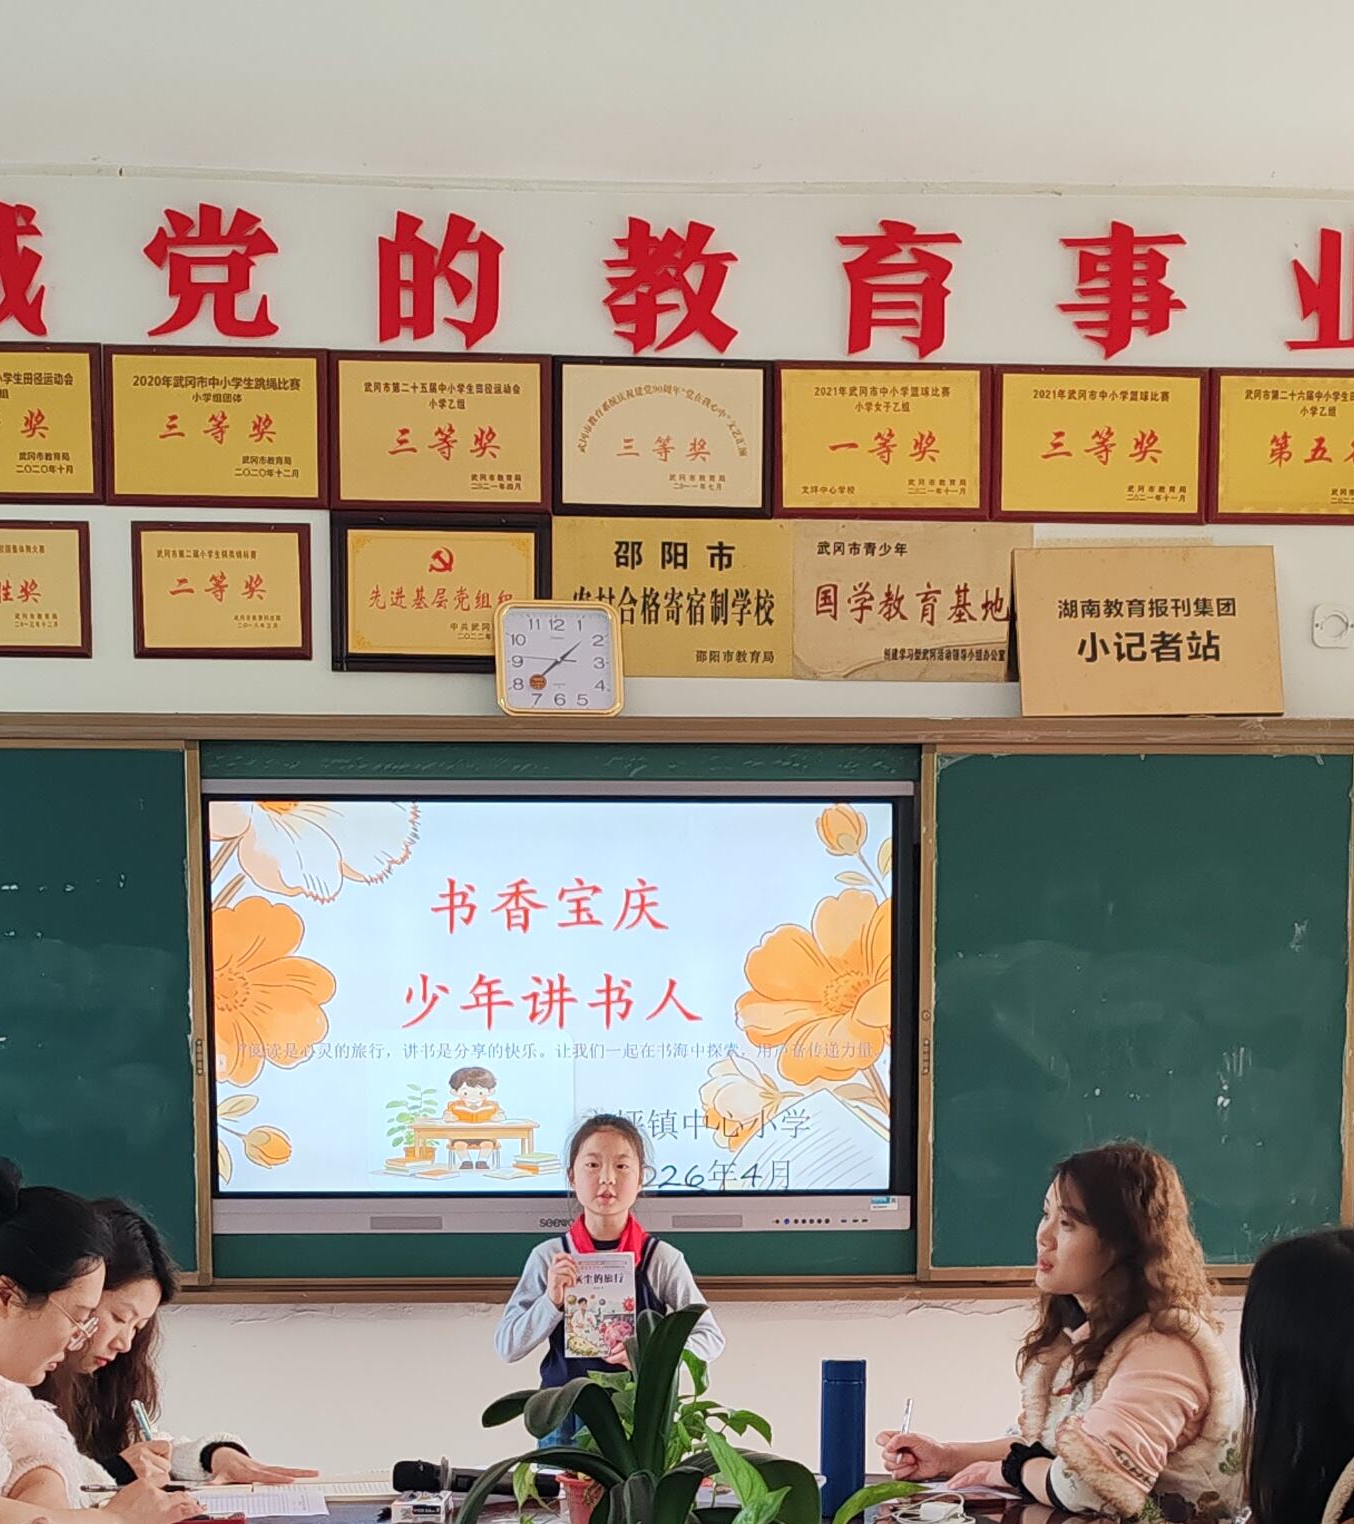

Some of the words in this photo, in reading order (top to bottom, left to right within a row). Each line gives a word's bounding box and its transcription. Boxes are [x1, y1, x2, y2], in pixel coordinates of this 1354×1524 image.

[133, 376, 301, 391] 2020年武冈市中小学生跳绳比赛
[364, 382, 521, 394] 武冈市第二十五届中小学生田径运动会
[814, 386, 951, 397] 2021年武冈市中小学篮球比赛
[1033, 389, 1170, 402] 2021年武冈市中小学篮球比赛
[192, 393, 242, 403] 小学组团体
[428, 399, 466, 410] 小学乙组
[854, 401, 910, 413] 小学女子乙组
[1300, 406, 1336, 417] 小学乙组
[159, 410, 277, 445] 三等奖
[388, 423, 501, 461] 三等奖
[828, 427, 940, 465] 一等奖
[1041, 425, 1162, 466] 三等奖
[616, 435, 710, 462] 三等奖
[19, 452, 70, 461] 武冈市教育局
[242, 456, 292, 465] 武冈市教育局
[471, 474, 522, 482] 武冈市教育局
[1126, 485, 1187, 494] 武冈市教育局
[817, 541, 908, 556] 武冈市青少年
[614, 541, 735, 571] 邵阳市
[169, 571, 267, 602] 二等奖
[816, 581, 1012, 627] 国学教育基地
[1057, 597, 1236, 619] 湖南教育报刊集团
[450, 622, 494, 631] 中共武冈
[529, 618, 540, 630] 11
[549, 619, 565, 631] 12
[577, 619, 582, 631] 1
[511, 634, 526, 646] 10
[591, 635, 604, 646] 2
[1077, 630, 1221, 663] 小记者站
[511, 655, 523, 667] 9
[593, 657, 605, 669] 3
[695, 650, 774, 664] 邵阳市教育局
[513, 678, 523, 690] 8
[594, 680, 605, 691] 4
[531, 693, 542, 705] 7
[554, 693, 566, 706] 6
[577, 694, 588, 706] 5
[430, 877, 669, 935] 书香宝庆
[400, 973, 703, 1030] 少年讲书人
[582, 1107, 810, 1140] 坪镇中心小学
